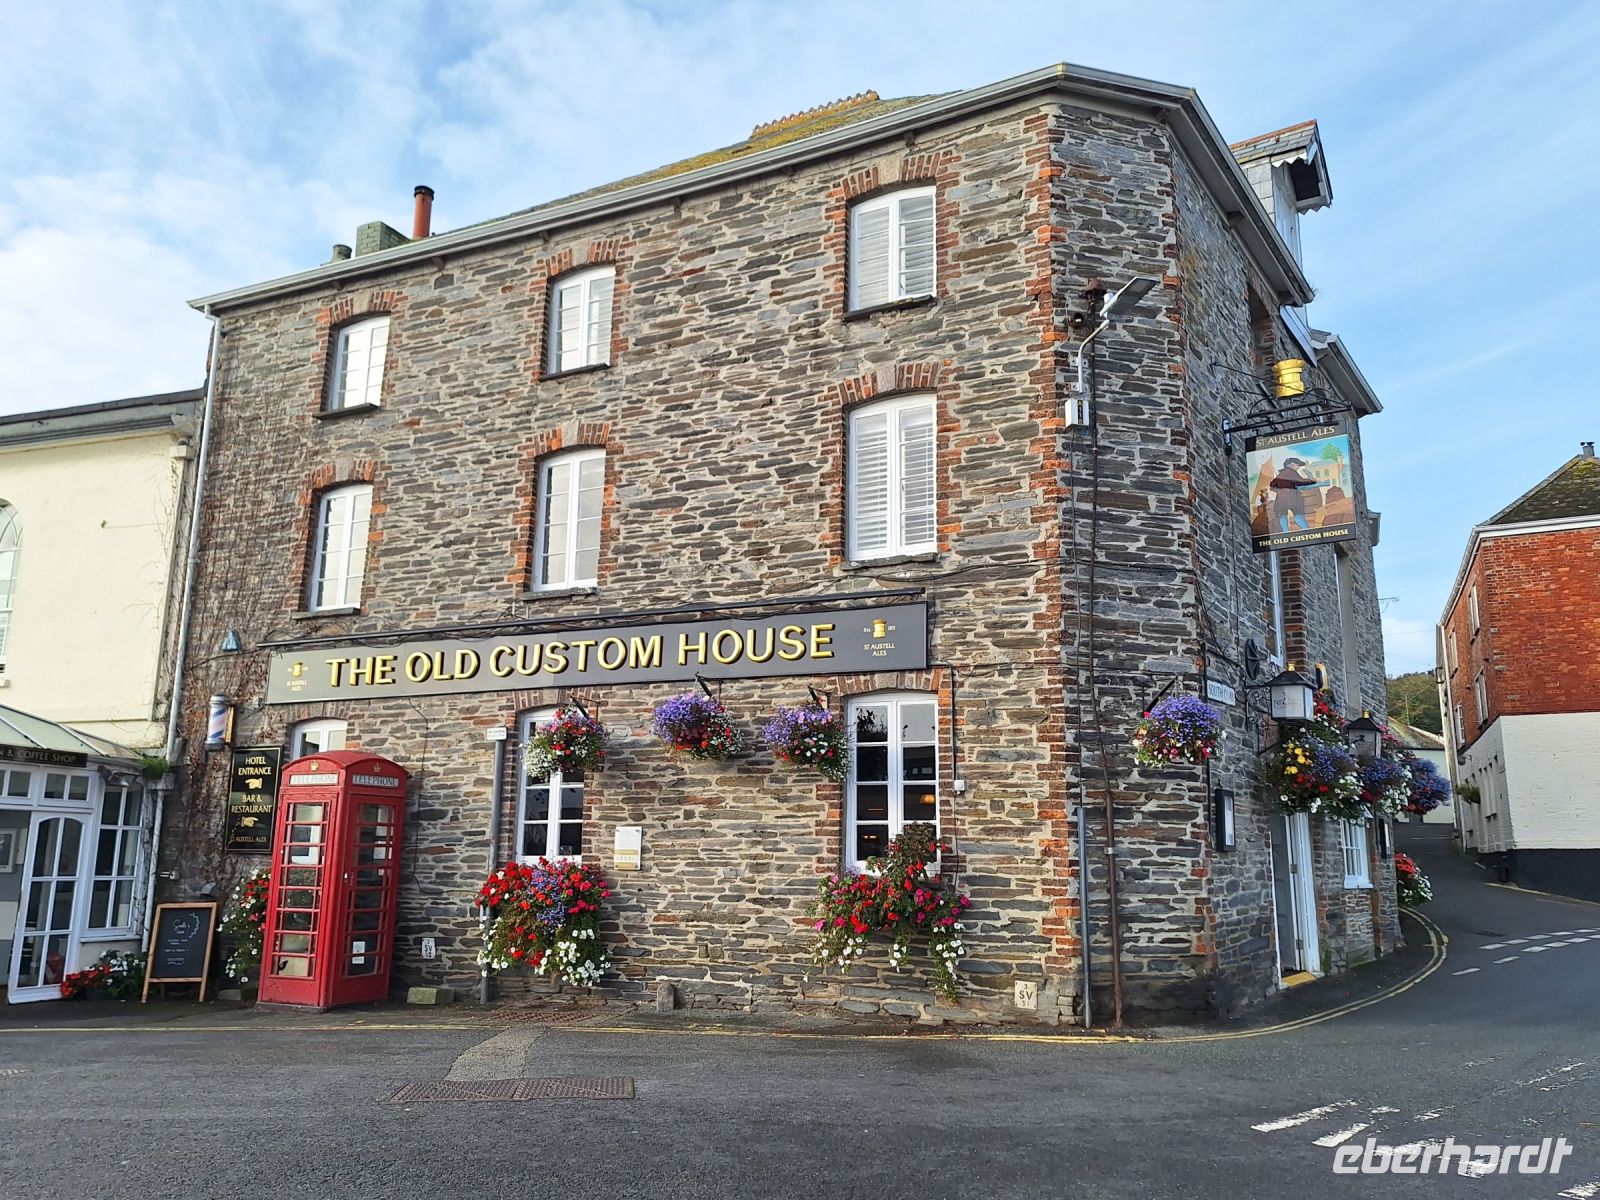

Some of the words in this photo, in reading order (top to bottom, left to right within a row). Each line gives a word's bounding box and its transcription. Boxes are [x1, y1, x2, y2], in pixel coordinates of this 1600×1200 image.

[1267, 431, 1307, 445] AUSTELL
[1311, 426, 1335, 437] ALES
[1258, 539, 1272, 547] THE
[1273, 537, 1289, 545] OLD
[1290, 533, 1321, 542] CUSTOM
[1323, 529, 1349, 538] HOUSE
[326, 655, 397, 687] THE
[405, 649, 480, 683] OLD
[489, 635, 663, 678] CUSTOM
[678, 623, 836, 664] HOUSE
[7, 749, 14, 757] &
[17, 750, 49, 761] COFFEE
[52, 752, 77, 763] SHOP
[245, 756, 267, 765] HOTEL
[238, 766, 272, 775] ENTRANCE
[242, 794, 256, 803] BAR
[257, 794, 262, 803] &
[231, 804, 273, 814] RESTAURANT
[1019, 990, 1033, 1000] SV
